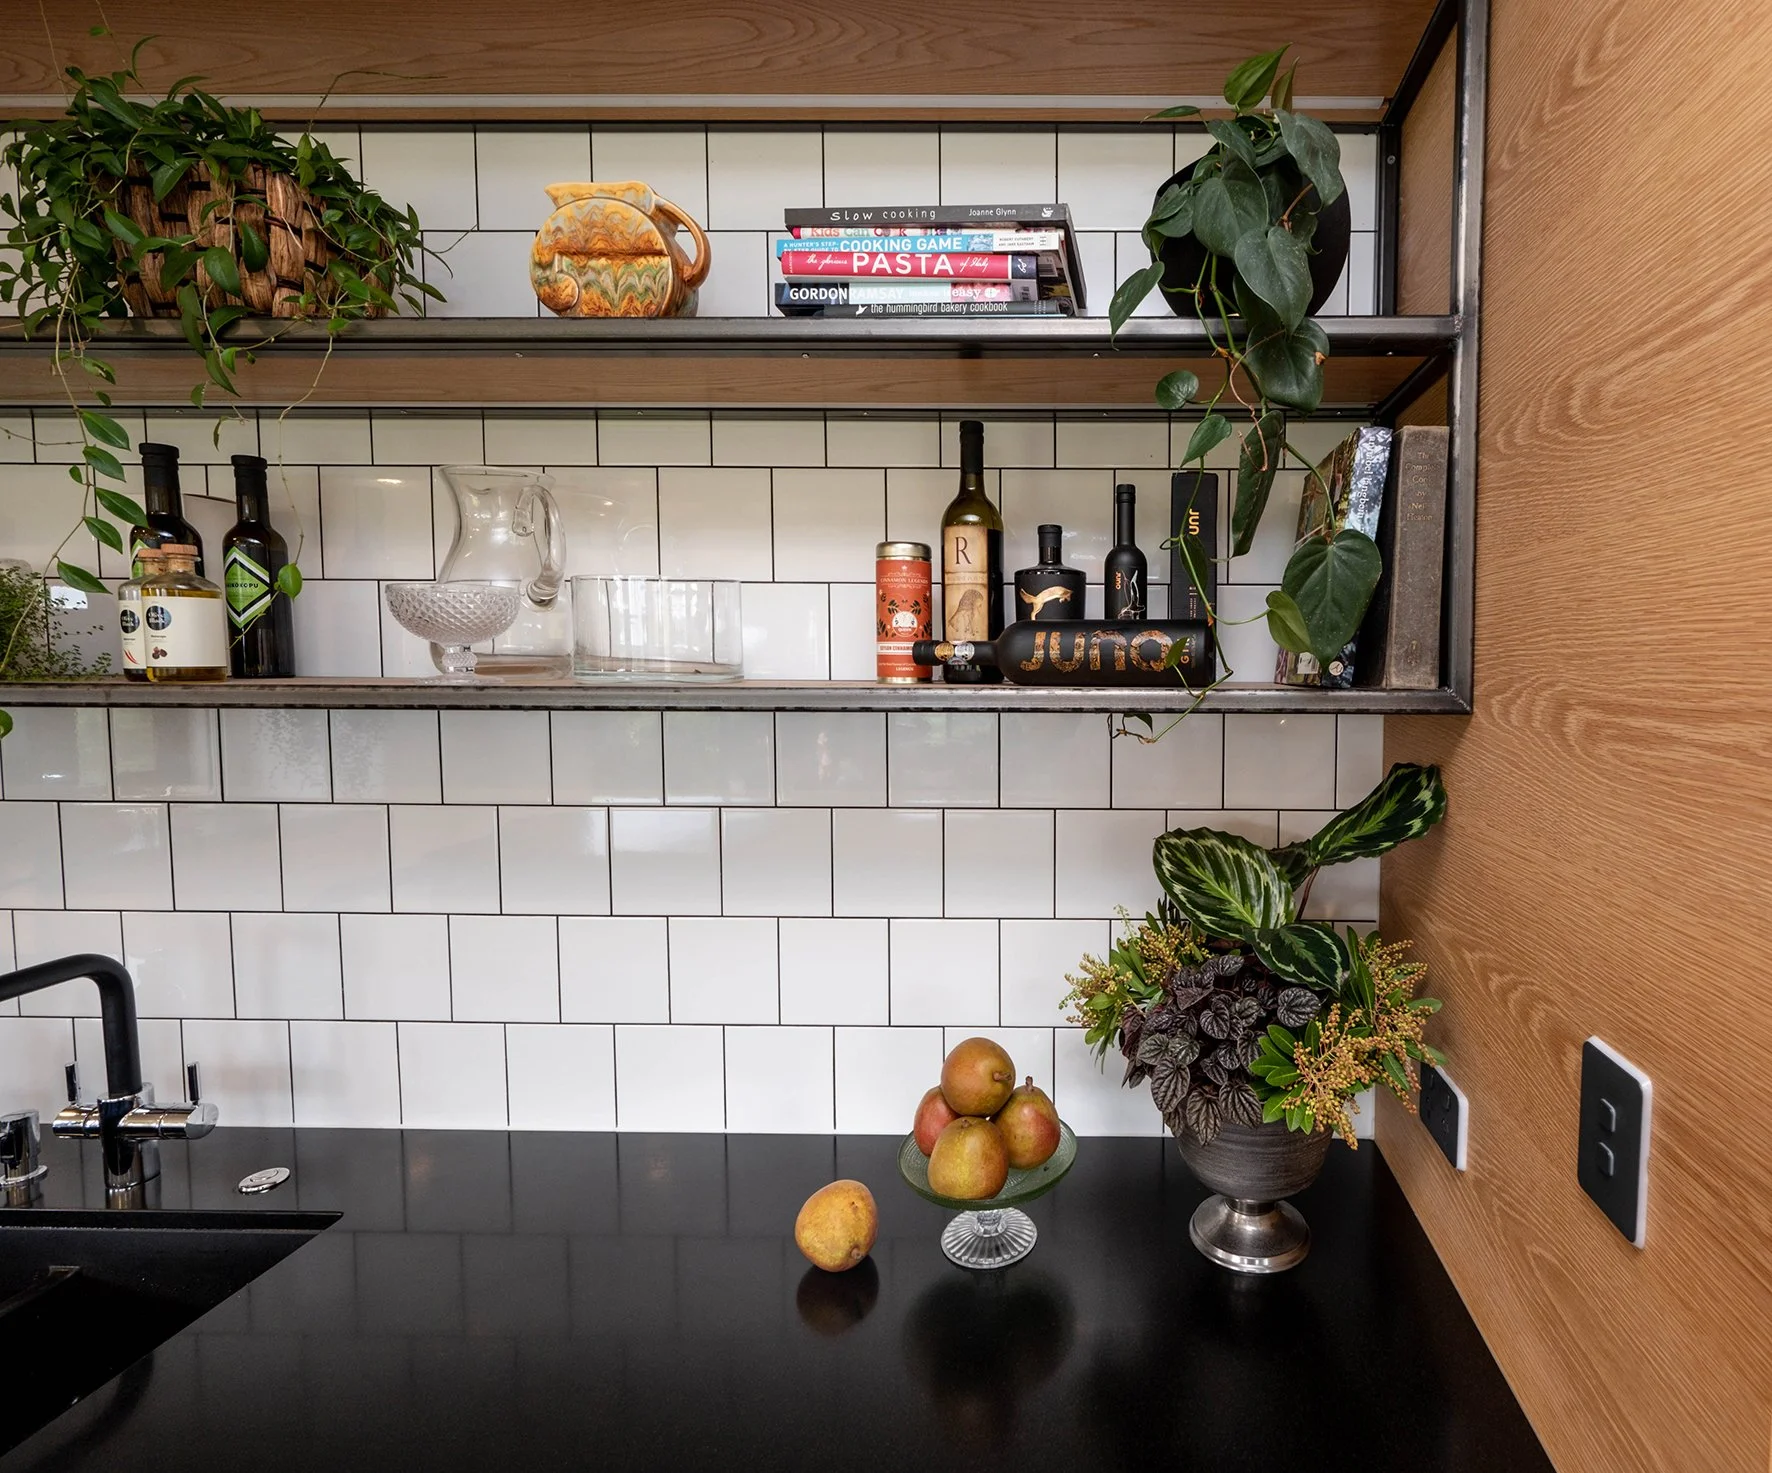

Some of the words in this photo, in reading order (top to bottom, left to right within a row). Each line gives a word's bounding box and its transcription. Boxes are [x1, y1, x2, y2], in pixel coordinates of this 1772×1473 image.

[883, 208, 936, 220] cooking
[968, 208, 994, 217] Joanne
[996, 207, 1017, 217] Glynn
[811, 227, 840, 237] Kids
[844, 227, 870, 237] Can
[840, 239, 912, 253] COOKING
[916, 237, 962, 251] GAME
[805, 254, 818, 264] the
[818, 254, 848, 270] glorious
[852, 253, 954, 275] PASTA
[960, 257, 969, 273] of
[790, 287, 848, 300] GORDON
[951, 287, 981, 299] easy
[870, 304, 883, 313] the
[886, 303, 938, 315] hummingbird
[940, 303, 966, 314] bakery
[970, 302, 1008, 313] cookbook
[955, 536, 971, 565] R
